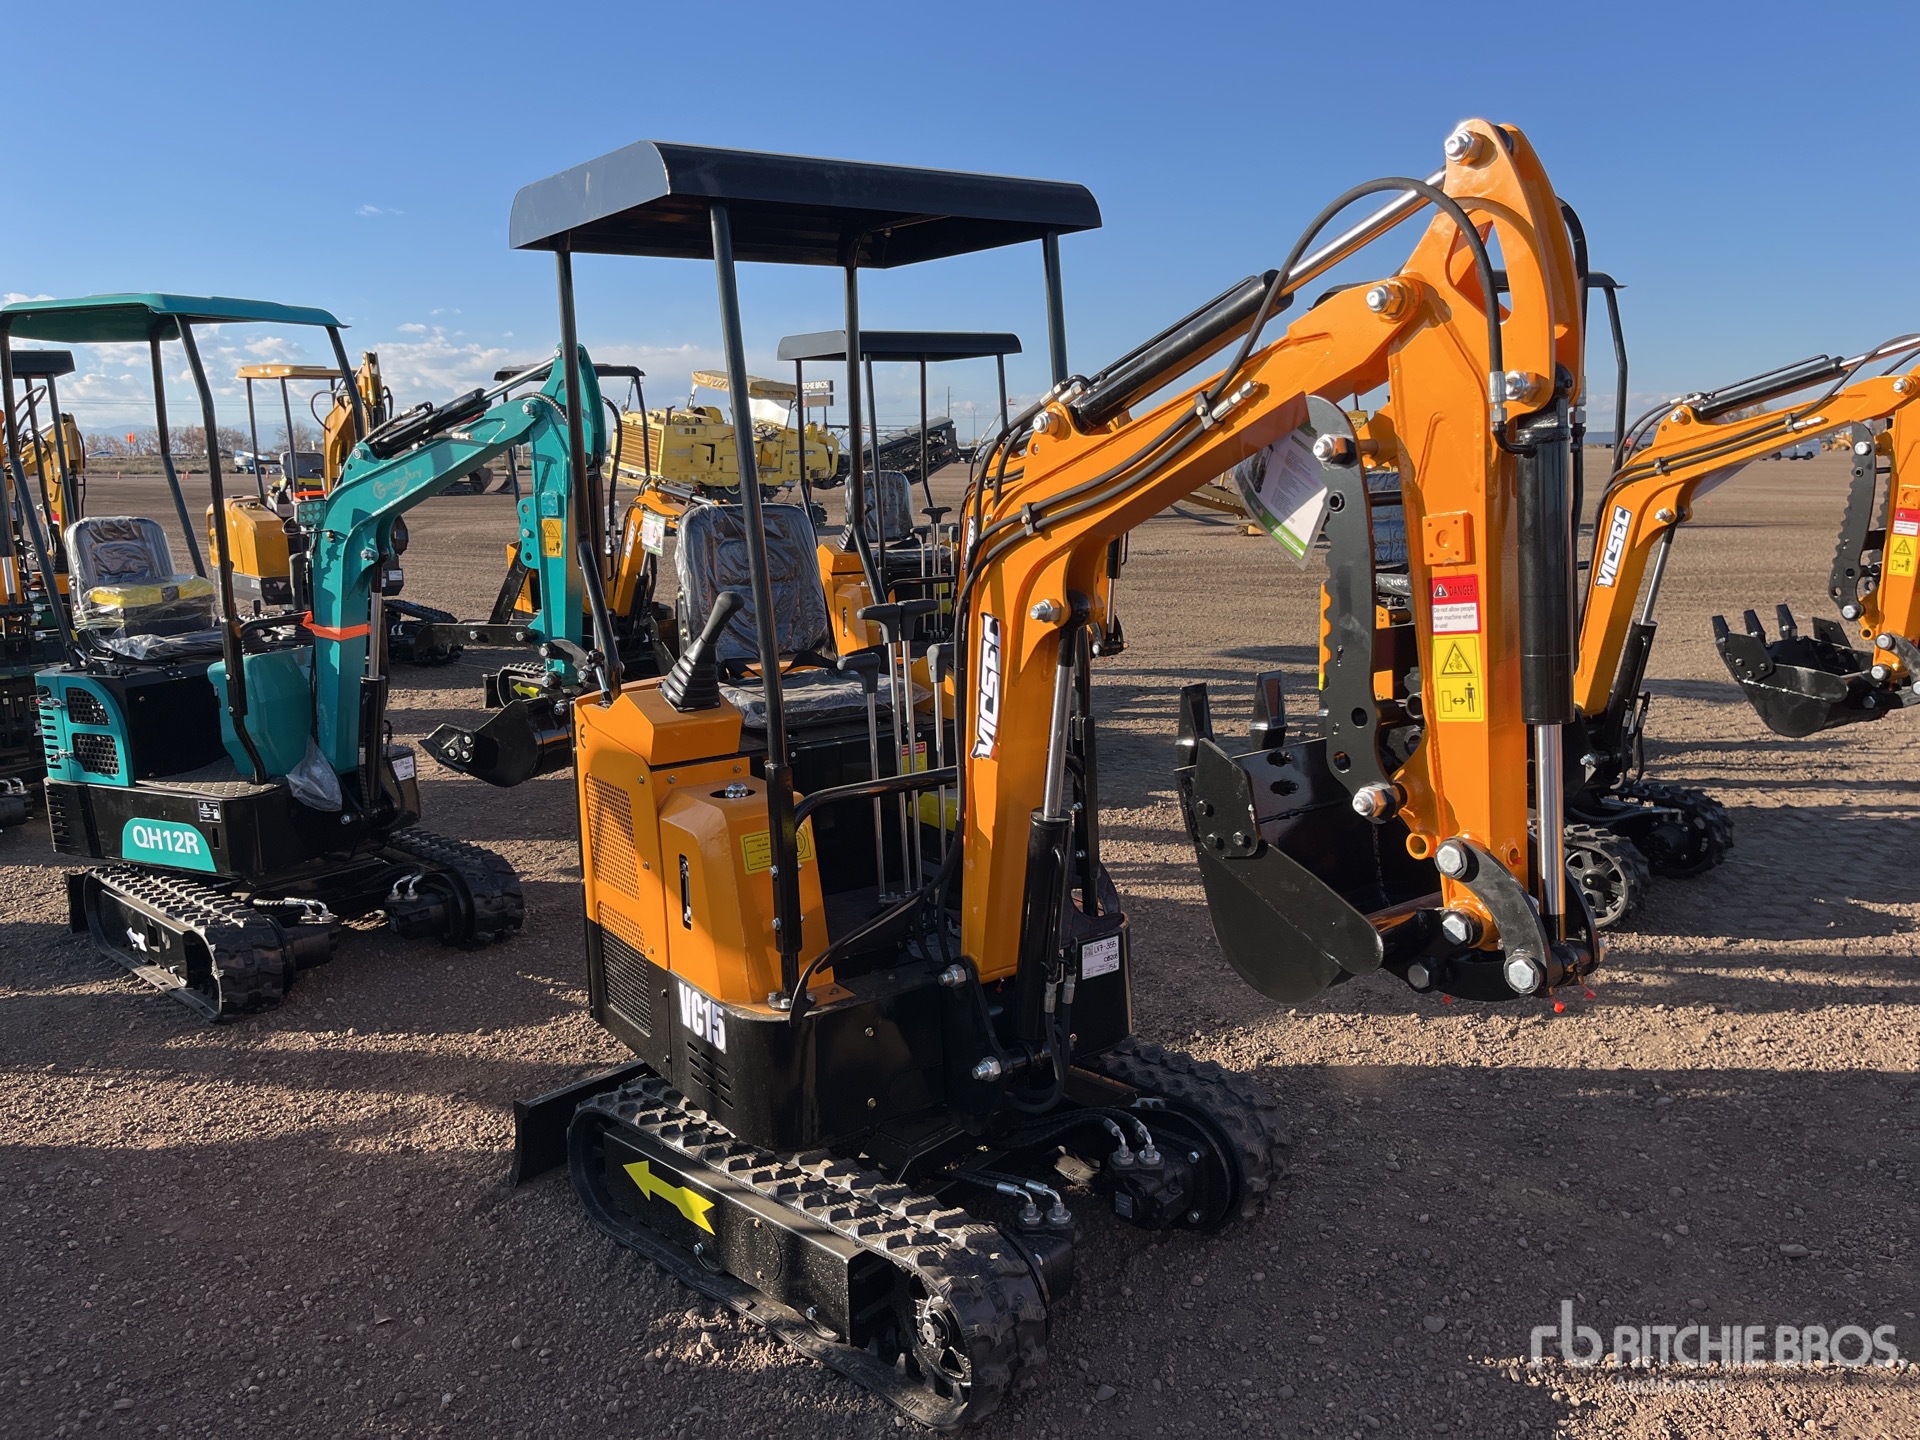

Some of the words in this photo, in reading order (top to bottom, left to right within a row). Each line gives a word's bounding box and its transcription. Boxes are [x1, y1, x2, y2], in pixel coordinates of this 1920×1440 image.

[1595, 505, 1632, 587] VICSEC
[1449, 585, 1475, 596] DANGER
[971, 612, 1000, 759] VICSEC
[132, 825, 200, 855] QH12R
[679, 980, 726, 1051] VC15
